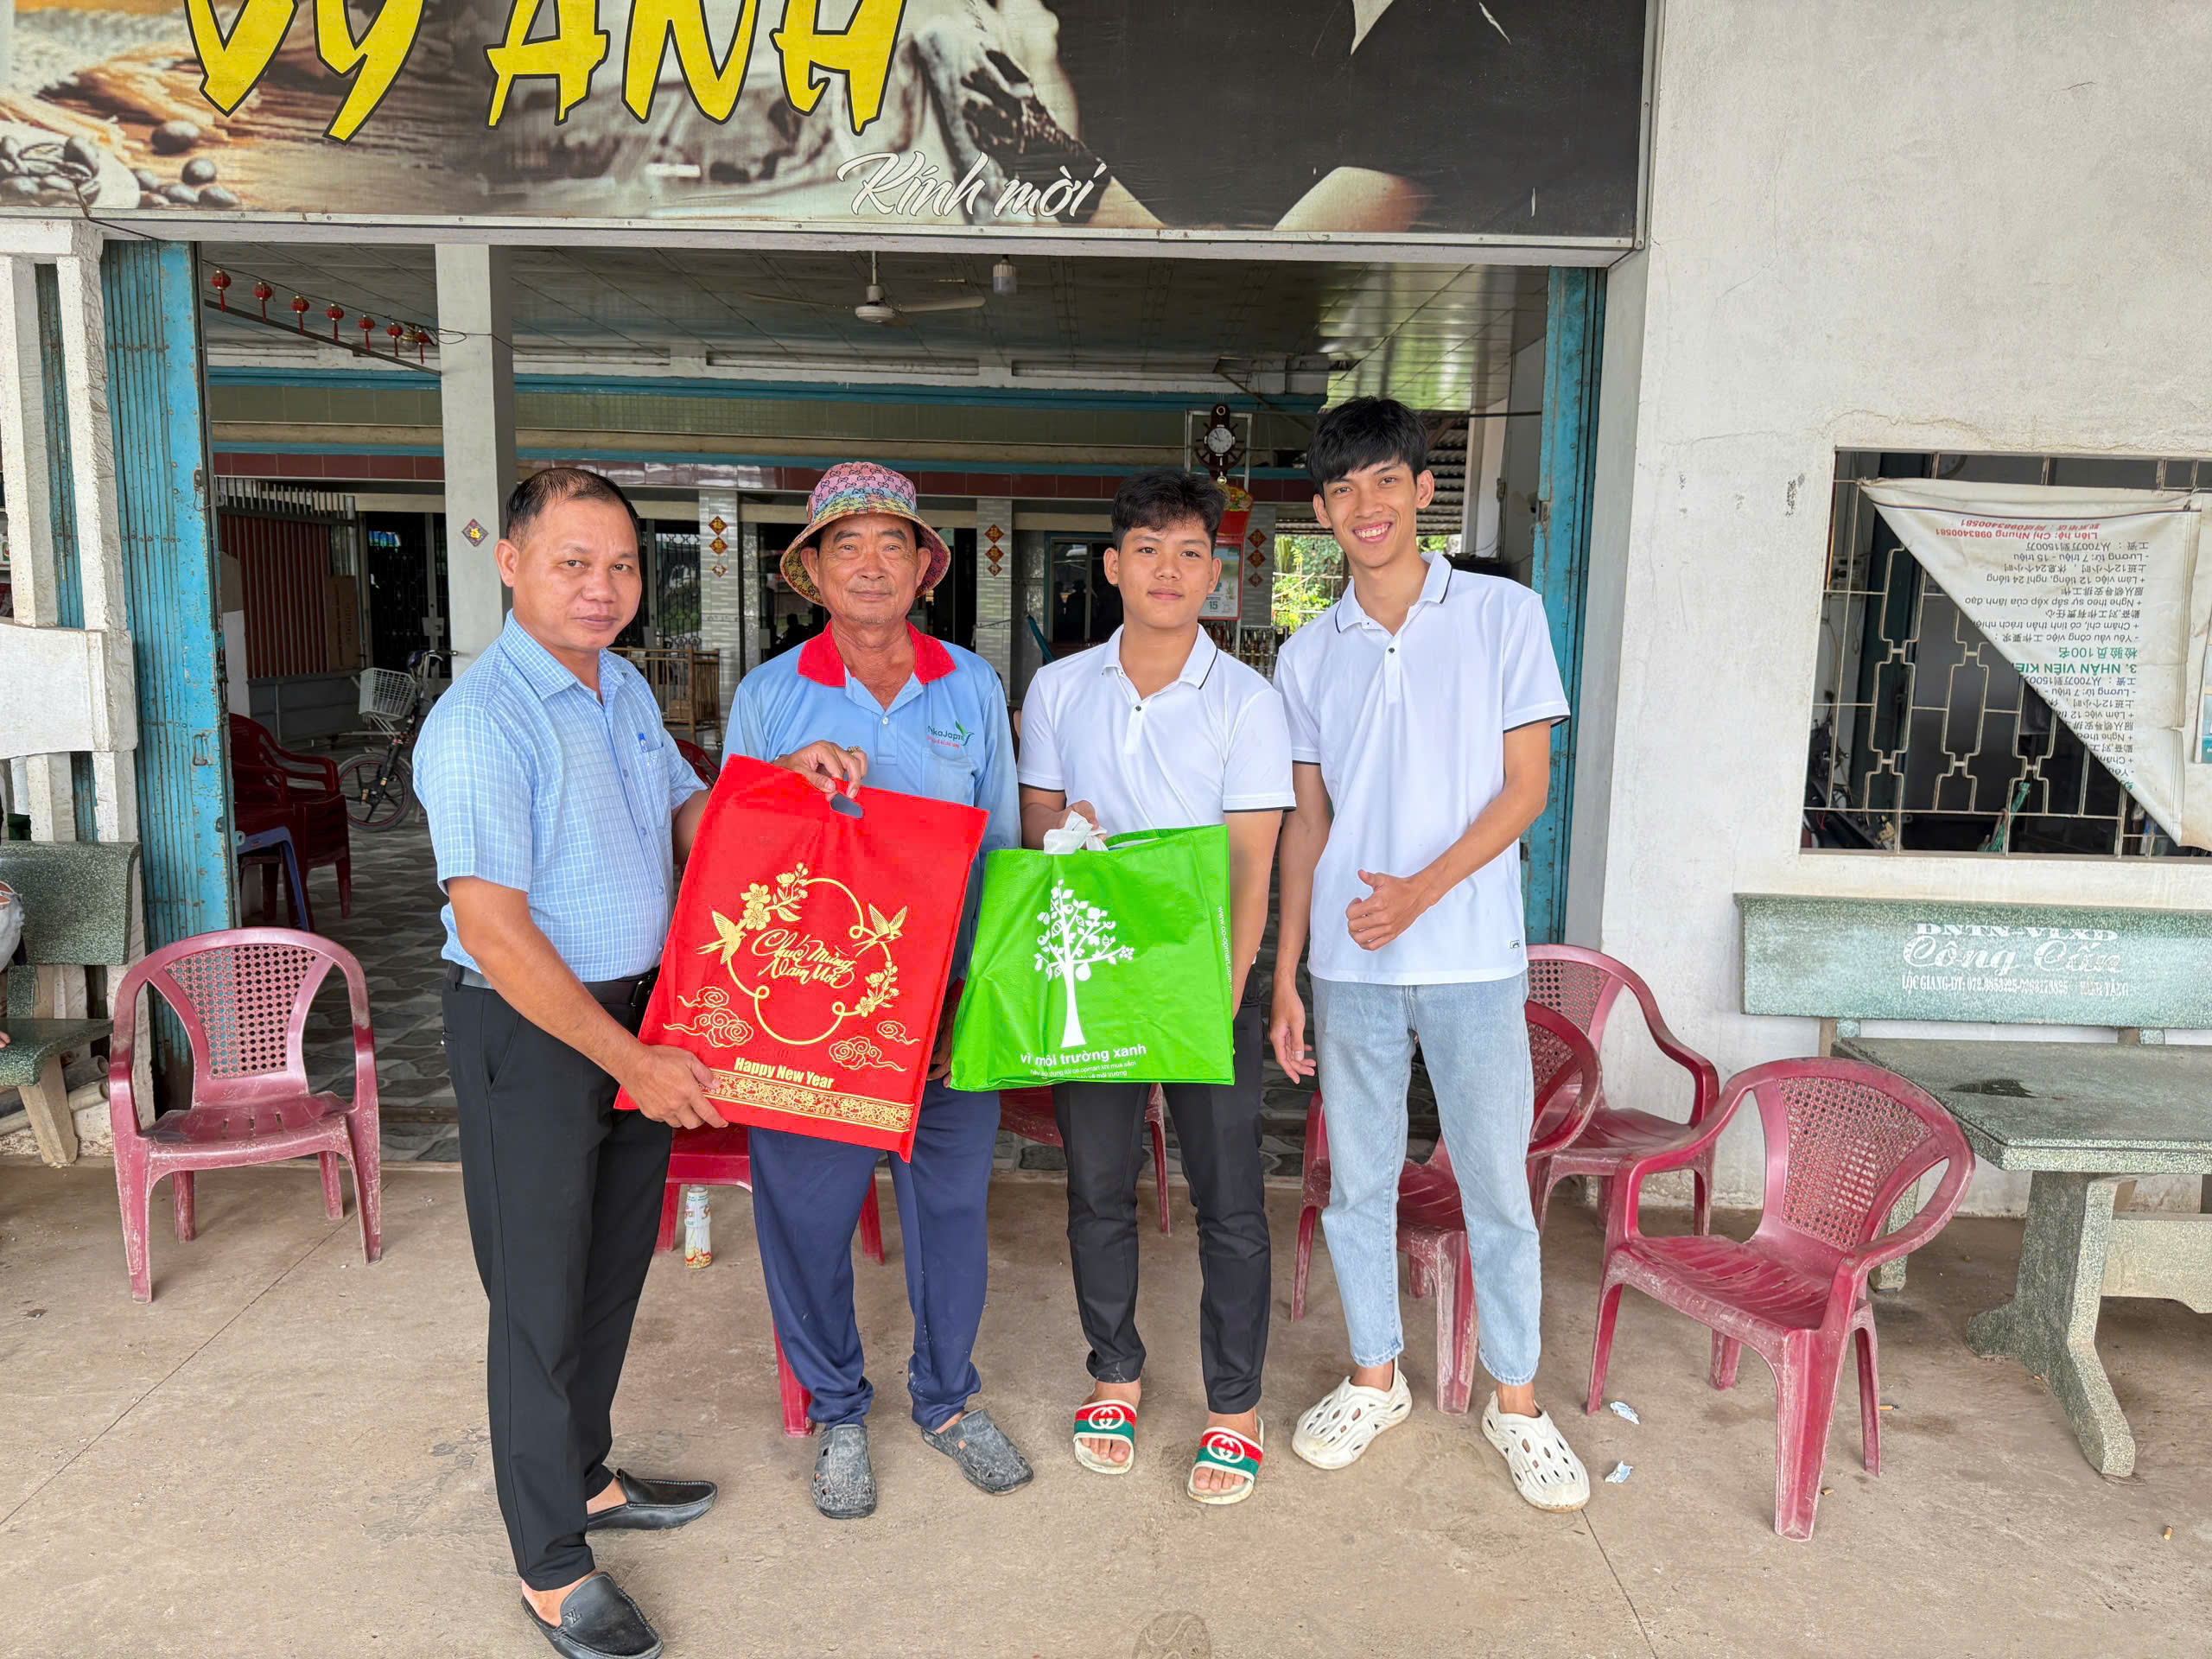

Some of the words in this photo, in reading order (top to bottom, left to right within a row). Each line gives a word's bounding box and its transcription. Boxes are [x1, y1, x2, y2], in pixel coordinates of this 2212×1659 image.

[836, 151, 989, 216] Kính
[993, 162, 1108, 217] mời
[1936, 528, 1992, 538] 0983400581
[1995, 530, 2030, 539] Nhung
[2033, 531, 2051, 540] Chị
[2074, 531, 2097, 540] Liên
[2013, 552, 2034, 562] triệu
[2059, 552, 2080, 563] triệu
[2108, 552, 2143, 562] Lương
[1986, 574, 2010, 584] tiếng
[2013, 575, 2024, 584] 24
[2095, 575, 2114, 584] việc
[2118, 576, 2137, 585] Làm
[1965, 596, 1983, 606] đạo
[1986, 598, 2007, 607] lãnh
[2072, 598, 2083, 607] sự
[2087, 599, 2107, 607] theo
[2110, 598, 2134, 607] Nghe
[1999, 621, 2023, 630] trách
[2046, 633, 2065, 642] việc
[2069, 632, 2091, 642] công
[2044, 664, 2075, 676] VIÊN
[2081, 664, 2120, 676] NHÂN
[2126, 664, 2136, 673] 3.
[1903, 936, 2019, 976] Công
[1020, 1052, 1032, 1065] vì
[1034, 1055, 1058, 1067] môi
[1060, 1050, 1109, 1065] trường
[1112, 1044, 1147, 1058] xanh
[734, 1057, 776, 1077] Happy
[776, 1065, 804, 1083] New
[806, 1071, 835, 1089] Year
